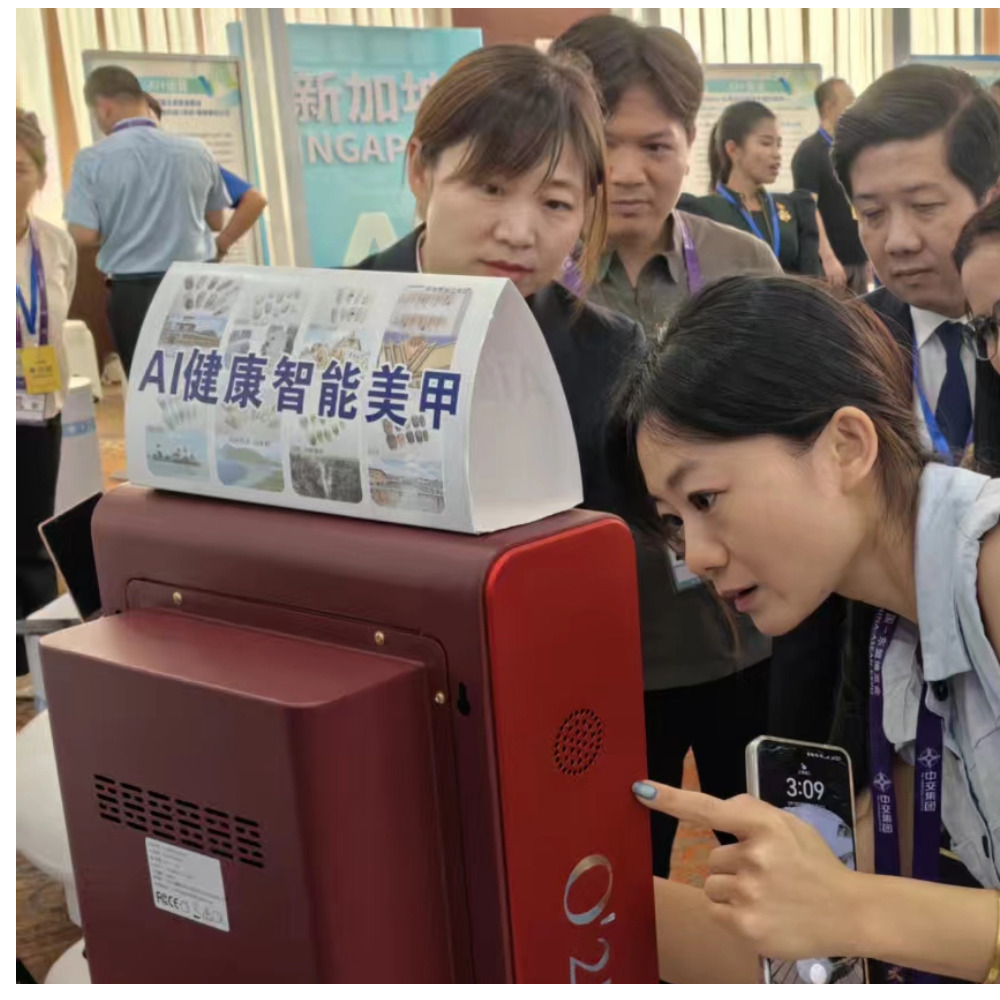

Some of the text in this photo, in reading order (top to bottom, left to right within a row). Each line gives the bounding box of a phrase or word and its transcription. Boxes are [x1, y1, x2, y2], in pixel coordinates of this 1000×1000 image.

[137, 347, 462, 431] AI健康智能美甲
[786, 777, 825, 800] 3:09
[924, 771, 937, 812] 中交集团
[880, 794, 893, 834] 中交集团
